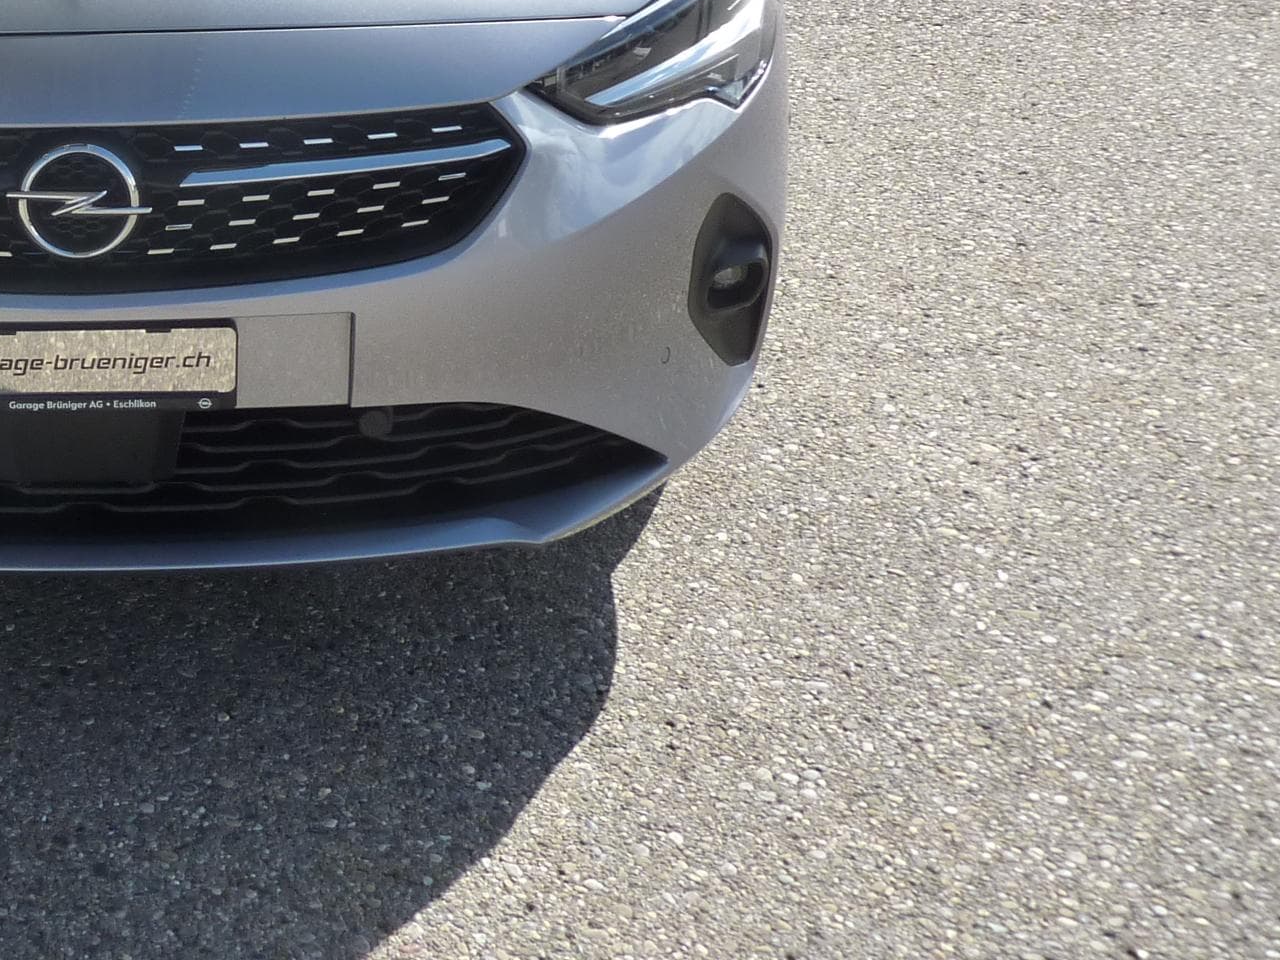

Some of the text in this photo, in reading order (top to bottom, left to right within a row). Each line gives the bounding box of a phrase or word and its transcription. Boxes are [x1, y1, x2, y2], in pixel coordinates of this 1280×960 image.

[9, 399, 157, 411] Garage Brüniger AG Eschlikon
